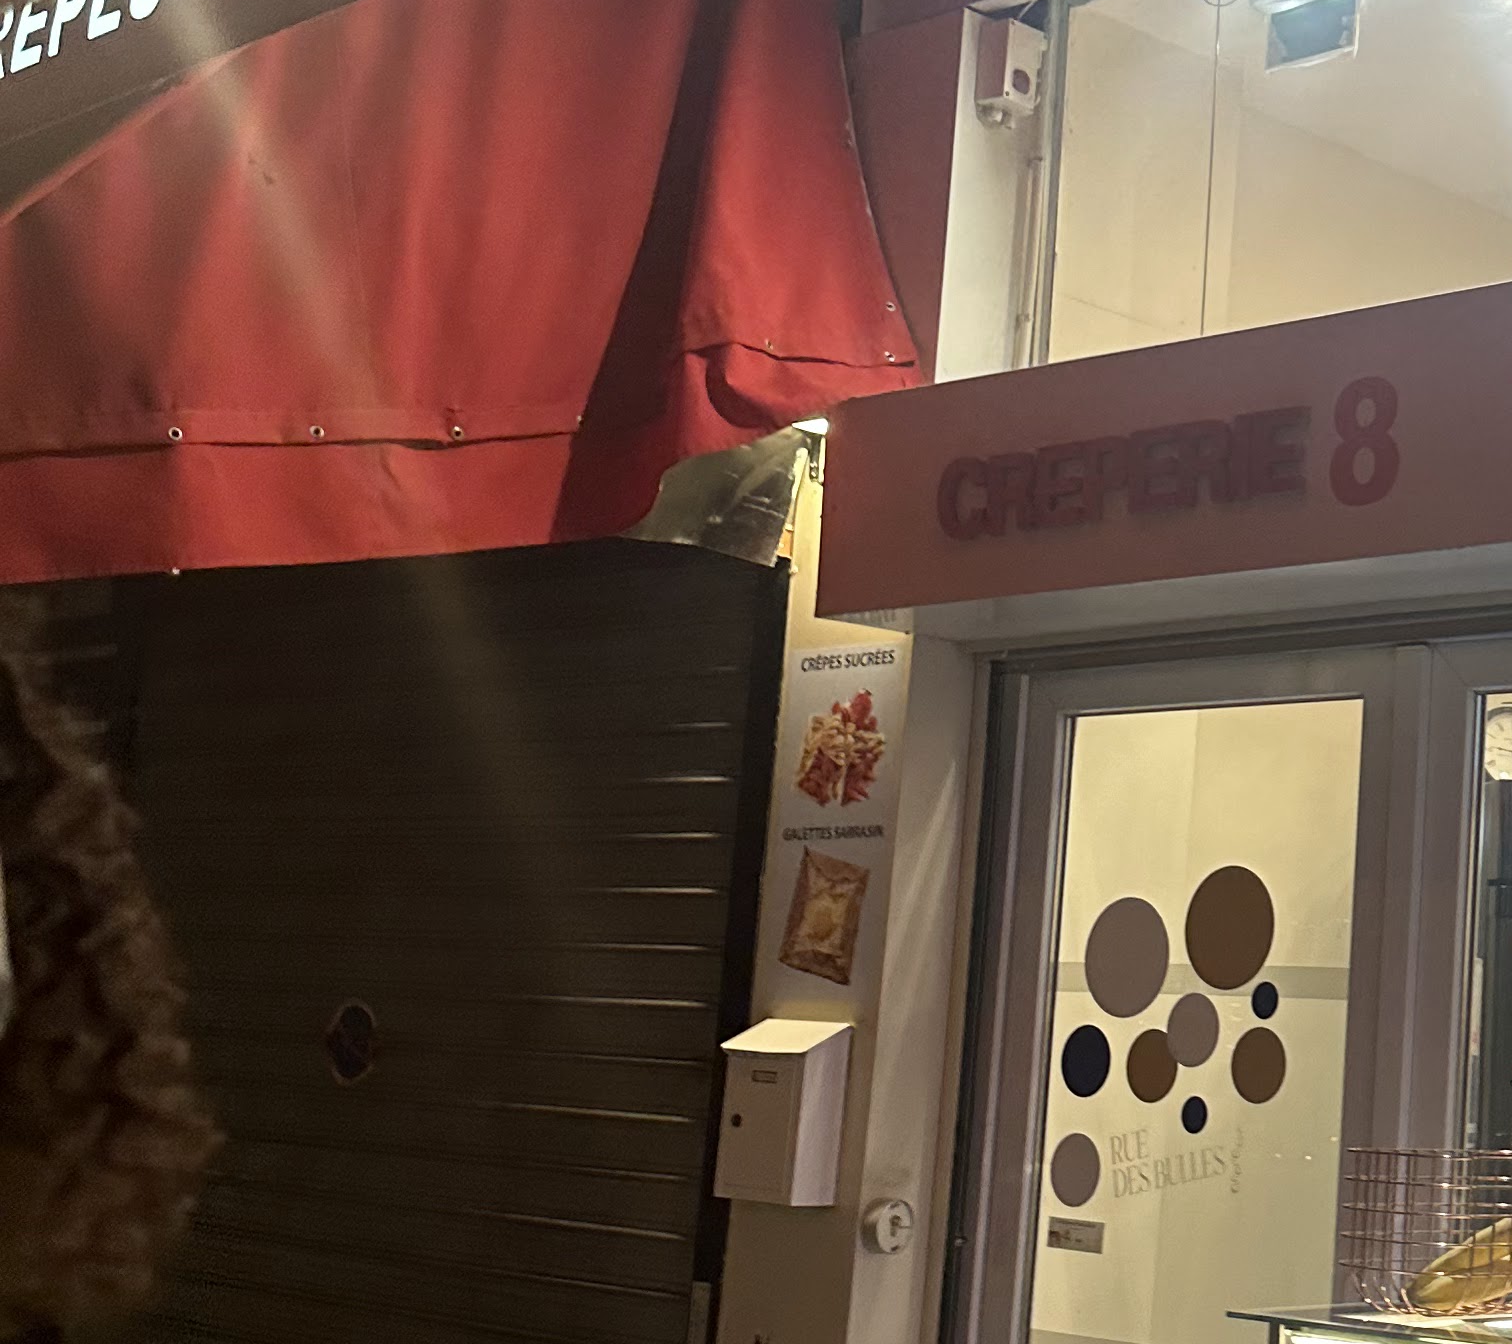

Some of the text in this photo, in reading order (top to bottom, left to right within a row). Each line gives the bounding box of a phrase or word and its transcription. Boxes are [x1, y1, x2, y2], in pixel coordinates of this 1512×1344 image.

[936, 376, 1399, 542] CREPERIE 8
[801, 648, 895, 672] CRÊPES SUCRÉES
[1110, 1129, 1149, 1165] RUE
[1112, 1162, 1152, 1198] DES
[1153, 1145, 1227, 1189] BULLES
